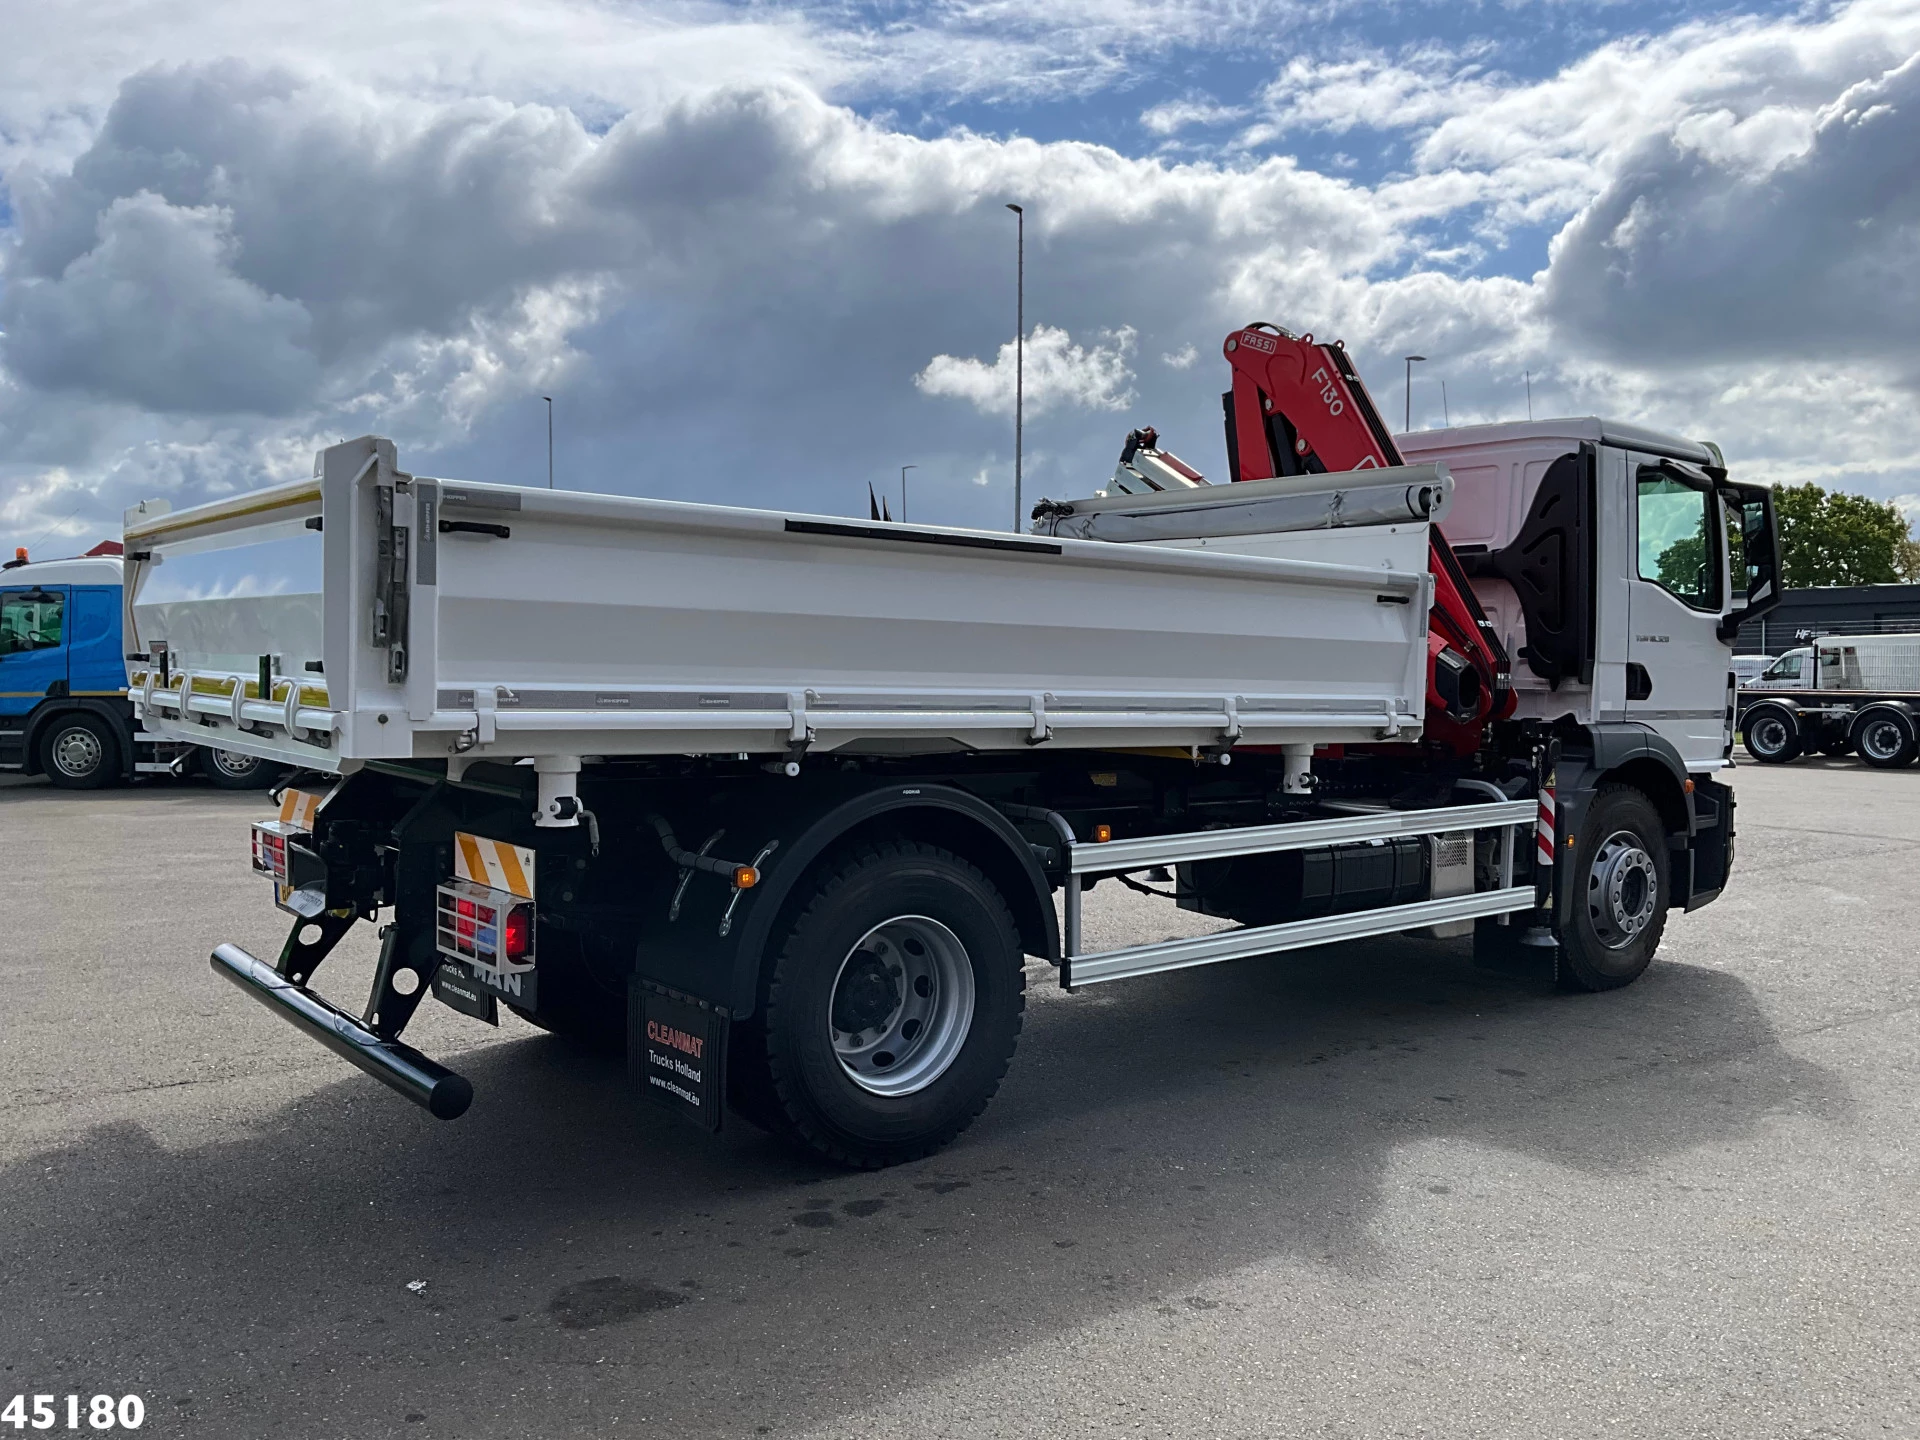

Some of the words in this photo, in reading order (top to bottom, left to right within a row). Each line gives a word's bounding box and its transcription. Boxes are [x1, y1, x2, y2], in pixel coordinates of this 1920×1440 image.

[1243, 334, 1274, 351] FASSI
[1311, 367, 1344, 416] F130
[1795, 629, 1811, 640] HF
[473, 964, 521, 997] MAN
[647, 1020, 703, 1059] CLEANMAT
[649, 1049, 674, 1070] Trucks
[675, 1059, 701, 1083] Holland
[649, 1075, 700, 1106] www.cleanmat.eu
